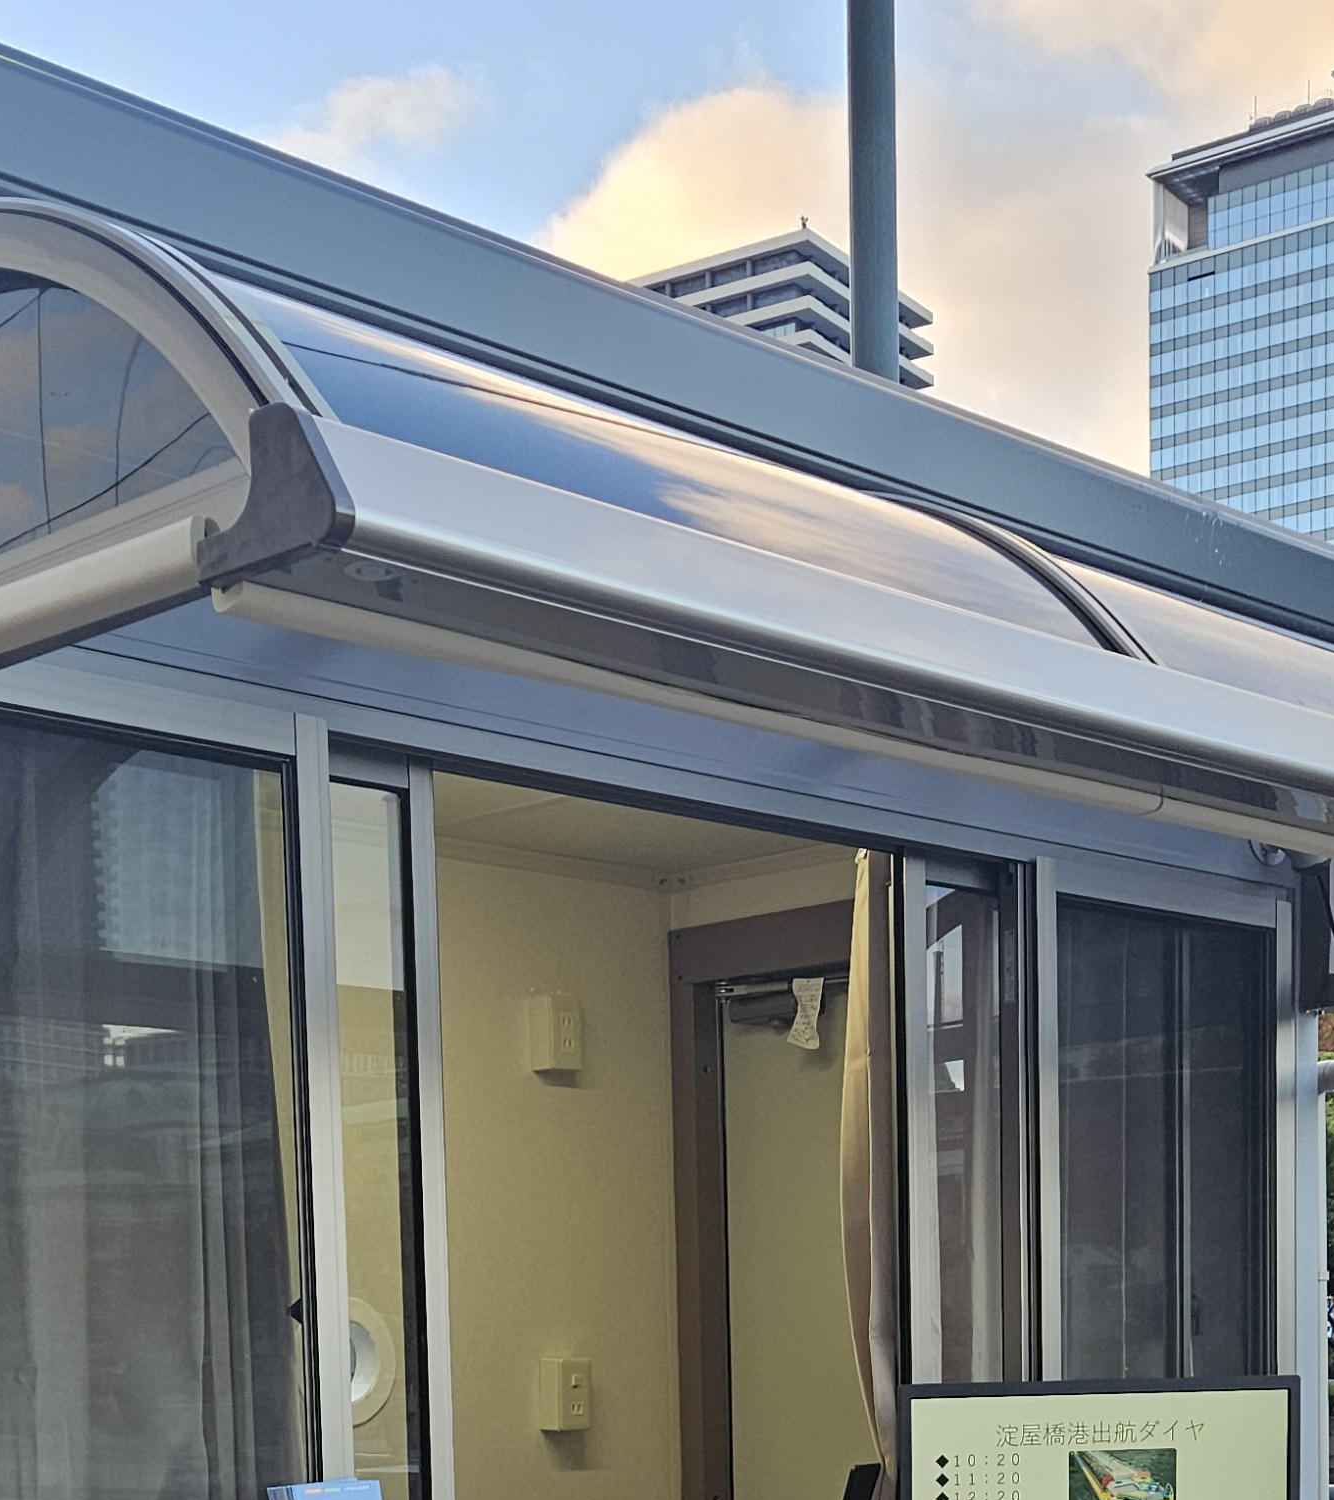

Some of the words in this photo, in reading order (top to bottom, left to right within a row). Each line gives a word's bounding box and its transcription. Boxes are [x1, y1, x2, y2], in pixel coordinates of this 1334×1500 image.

[996, 1420, 1205, 1446] 淀屋橋港出航ダイヤ
[954, 1453, 1019, 1467] 10:20
[955, 1472, 1019, 1486] 11:20
